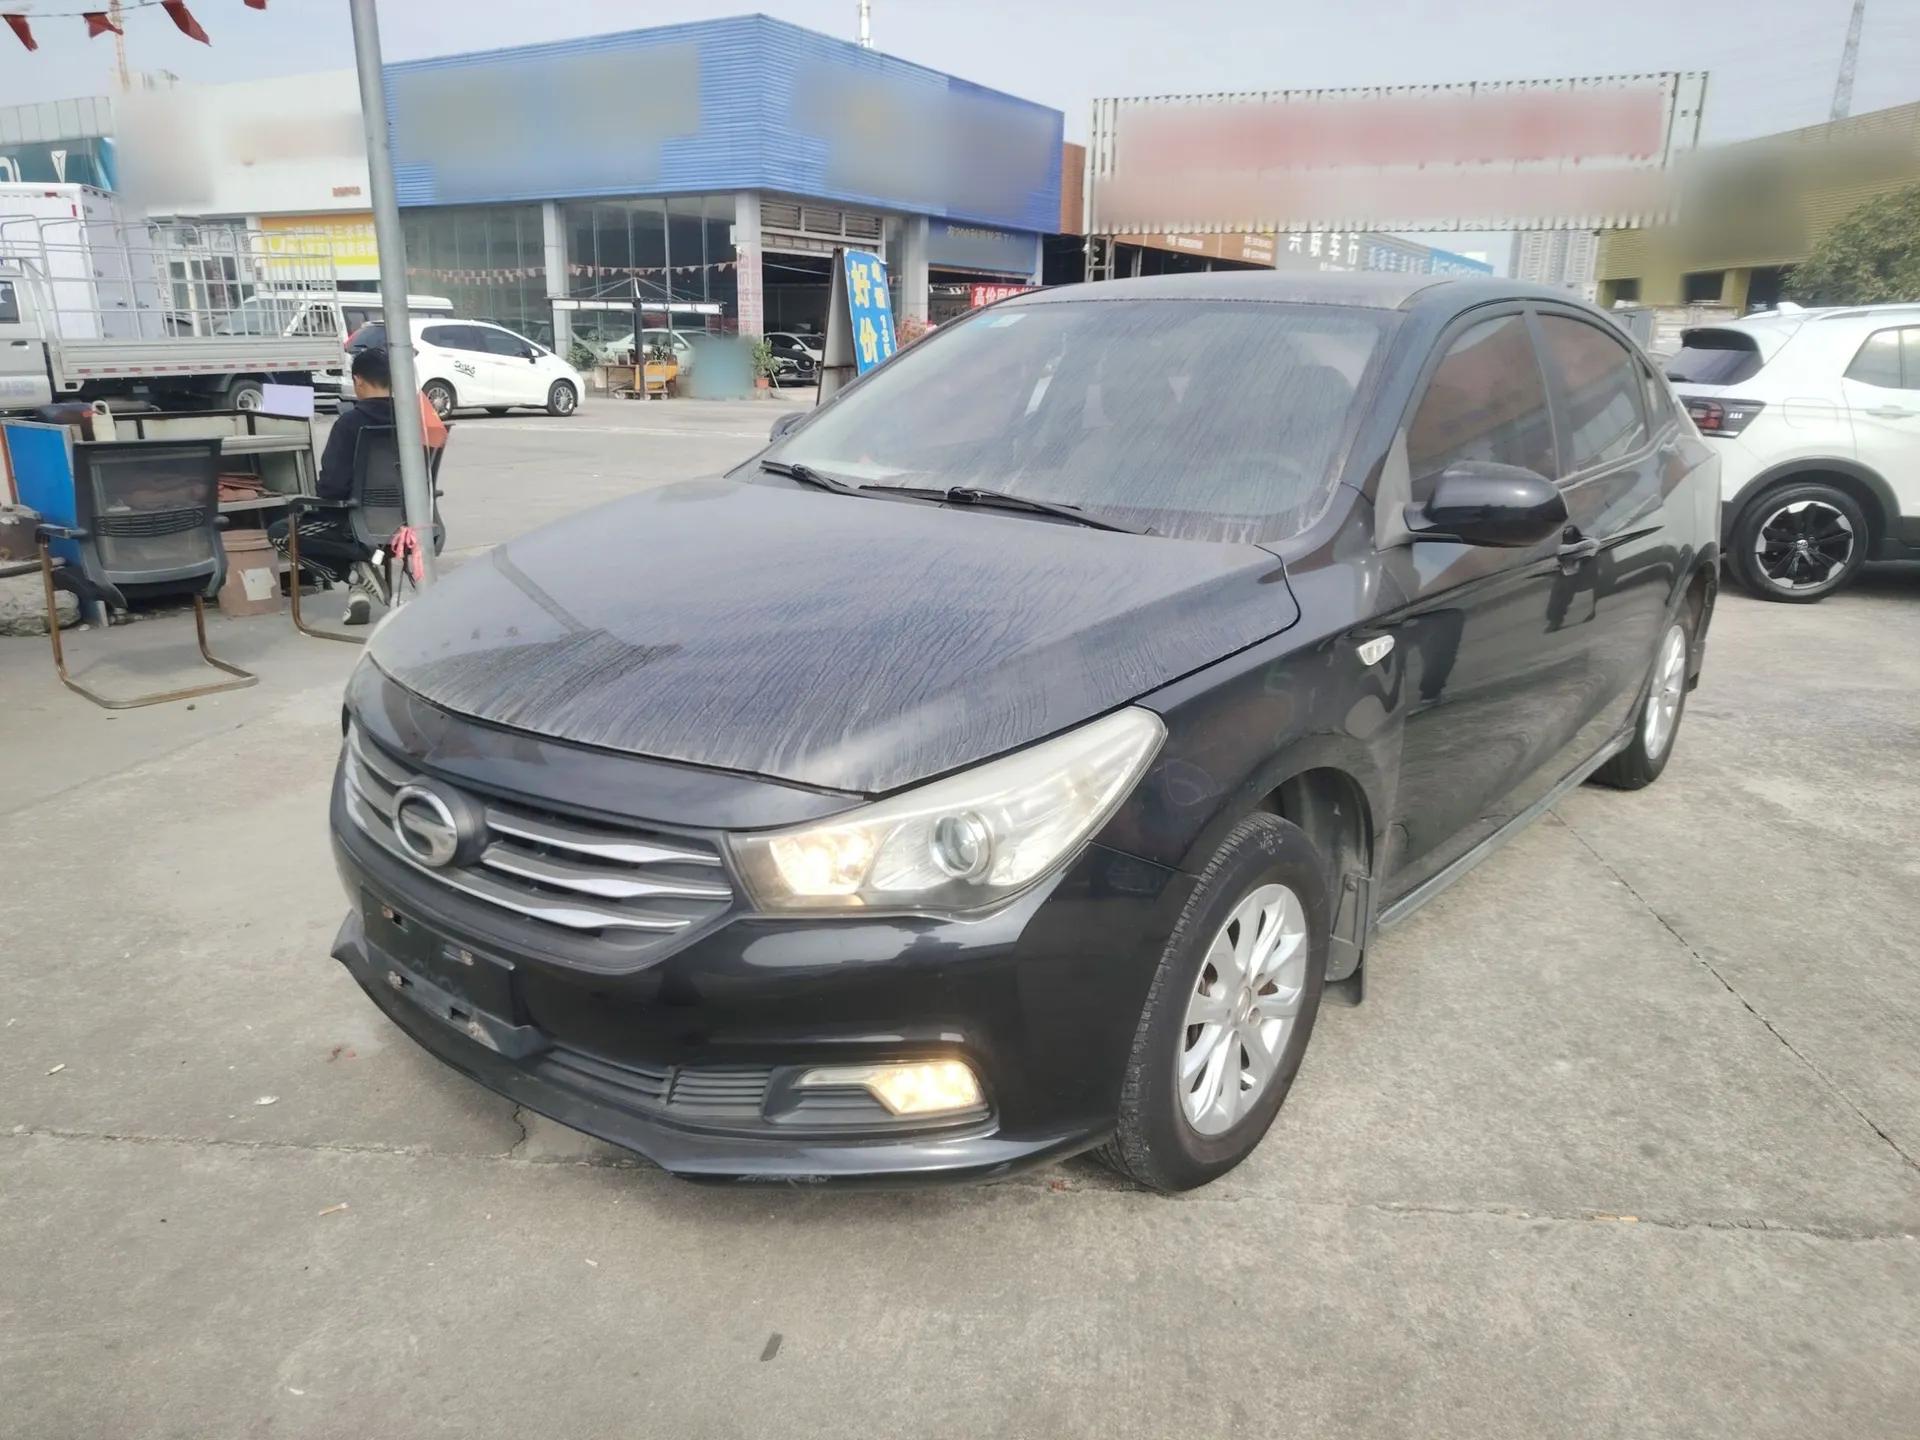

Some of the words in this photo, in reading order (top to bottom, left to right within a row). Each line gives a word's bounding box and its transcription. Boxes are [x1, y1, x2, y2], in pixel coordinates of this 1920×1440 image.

[851, 260, 878, 363] 好价
[974, 287, 1033, 306] 高价回
